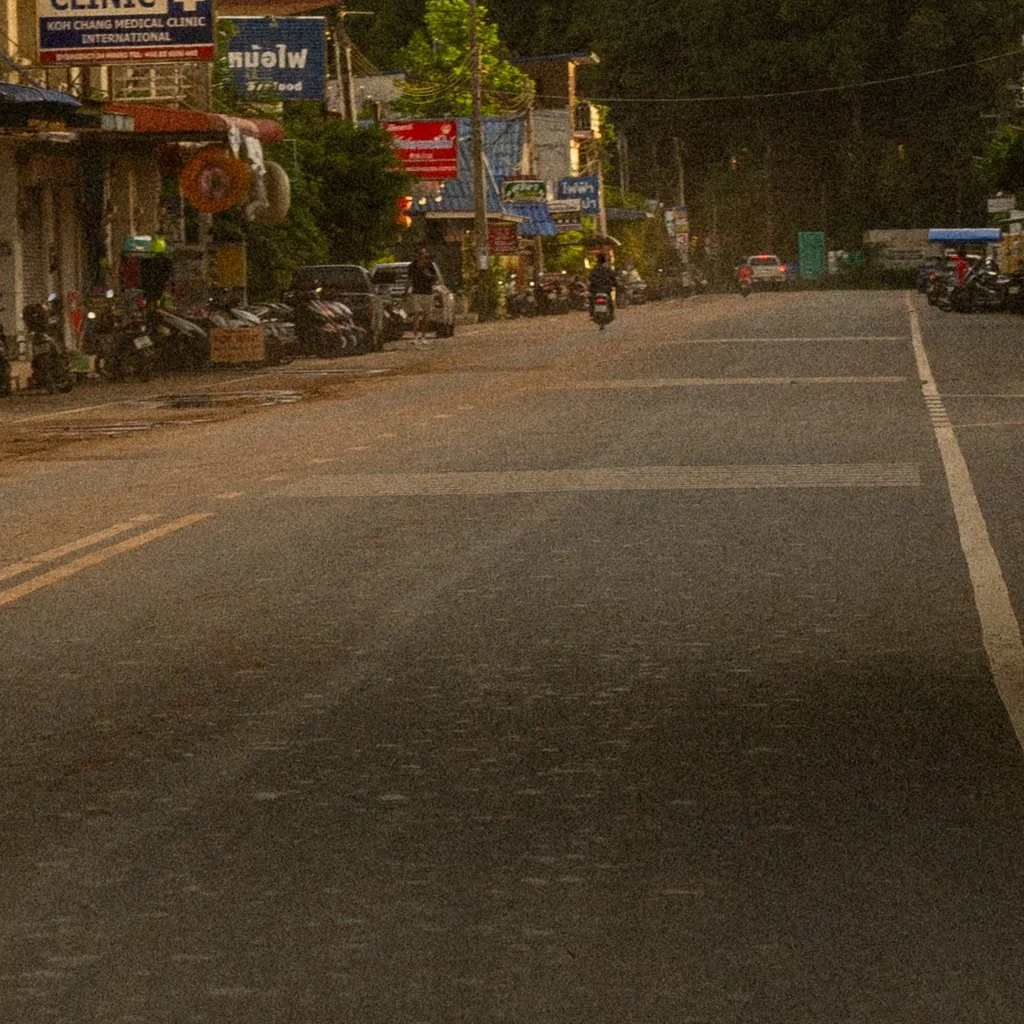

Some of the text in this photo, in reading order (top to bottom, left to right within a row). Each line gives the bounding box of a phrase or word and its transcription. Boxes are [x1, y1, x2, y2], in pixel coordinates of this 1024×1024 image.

[47, 16, 206, 31] KOH CHANG MEDICAL CLINIC
[81, 31, 172, 44] INTERNATIONAL
[227, 43, 309, 69] หม้อไฟ
